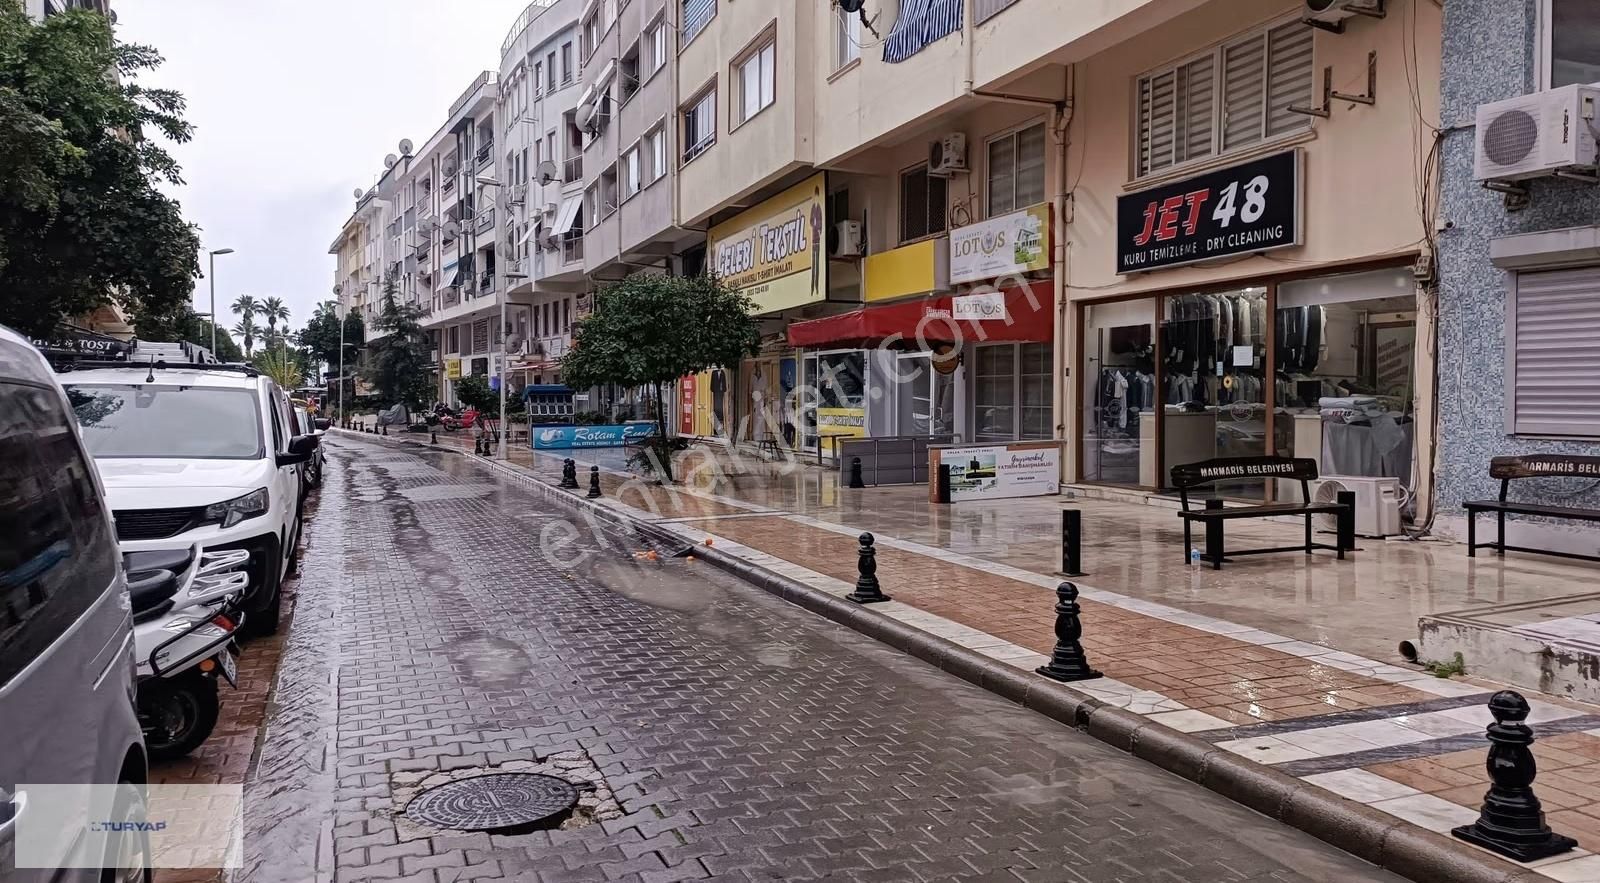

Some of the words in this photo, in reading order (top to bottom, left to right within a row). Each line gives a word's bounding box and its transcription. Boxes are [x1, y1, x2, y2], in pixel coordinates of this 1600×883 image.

[1133, 188, 1209, 246] JET
[1212, 175, 1269, 228] 48
[954, 231, 1005, 258] LOTUS
[1124, 251, 1146, 266] KURU
[1206, 235, 1225, 251] DRY
[1228, 224, 1283, 247] CLEANING
[956, 302, 1002, 315] LOTUS
[79, 339, 115, 350] TOST
[1200, 463, 1245, 477] MARMARİS
